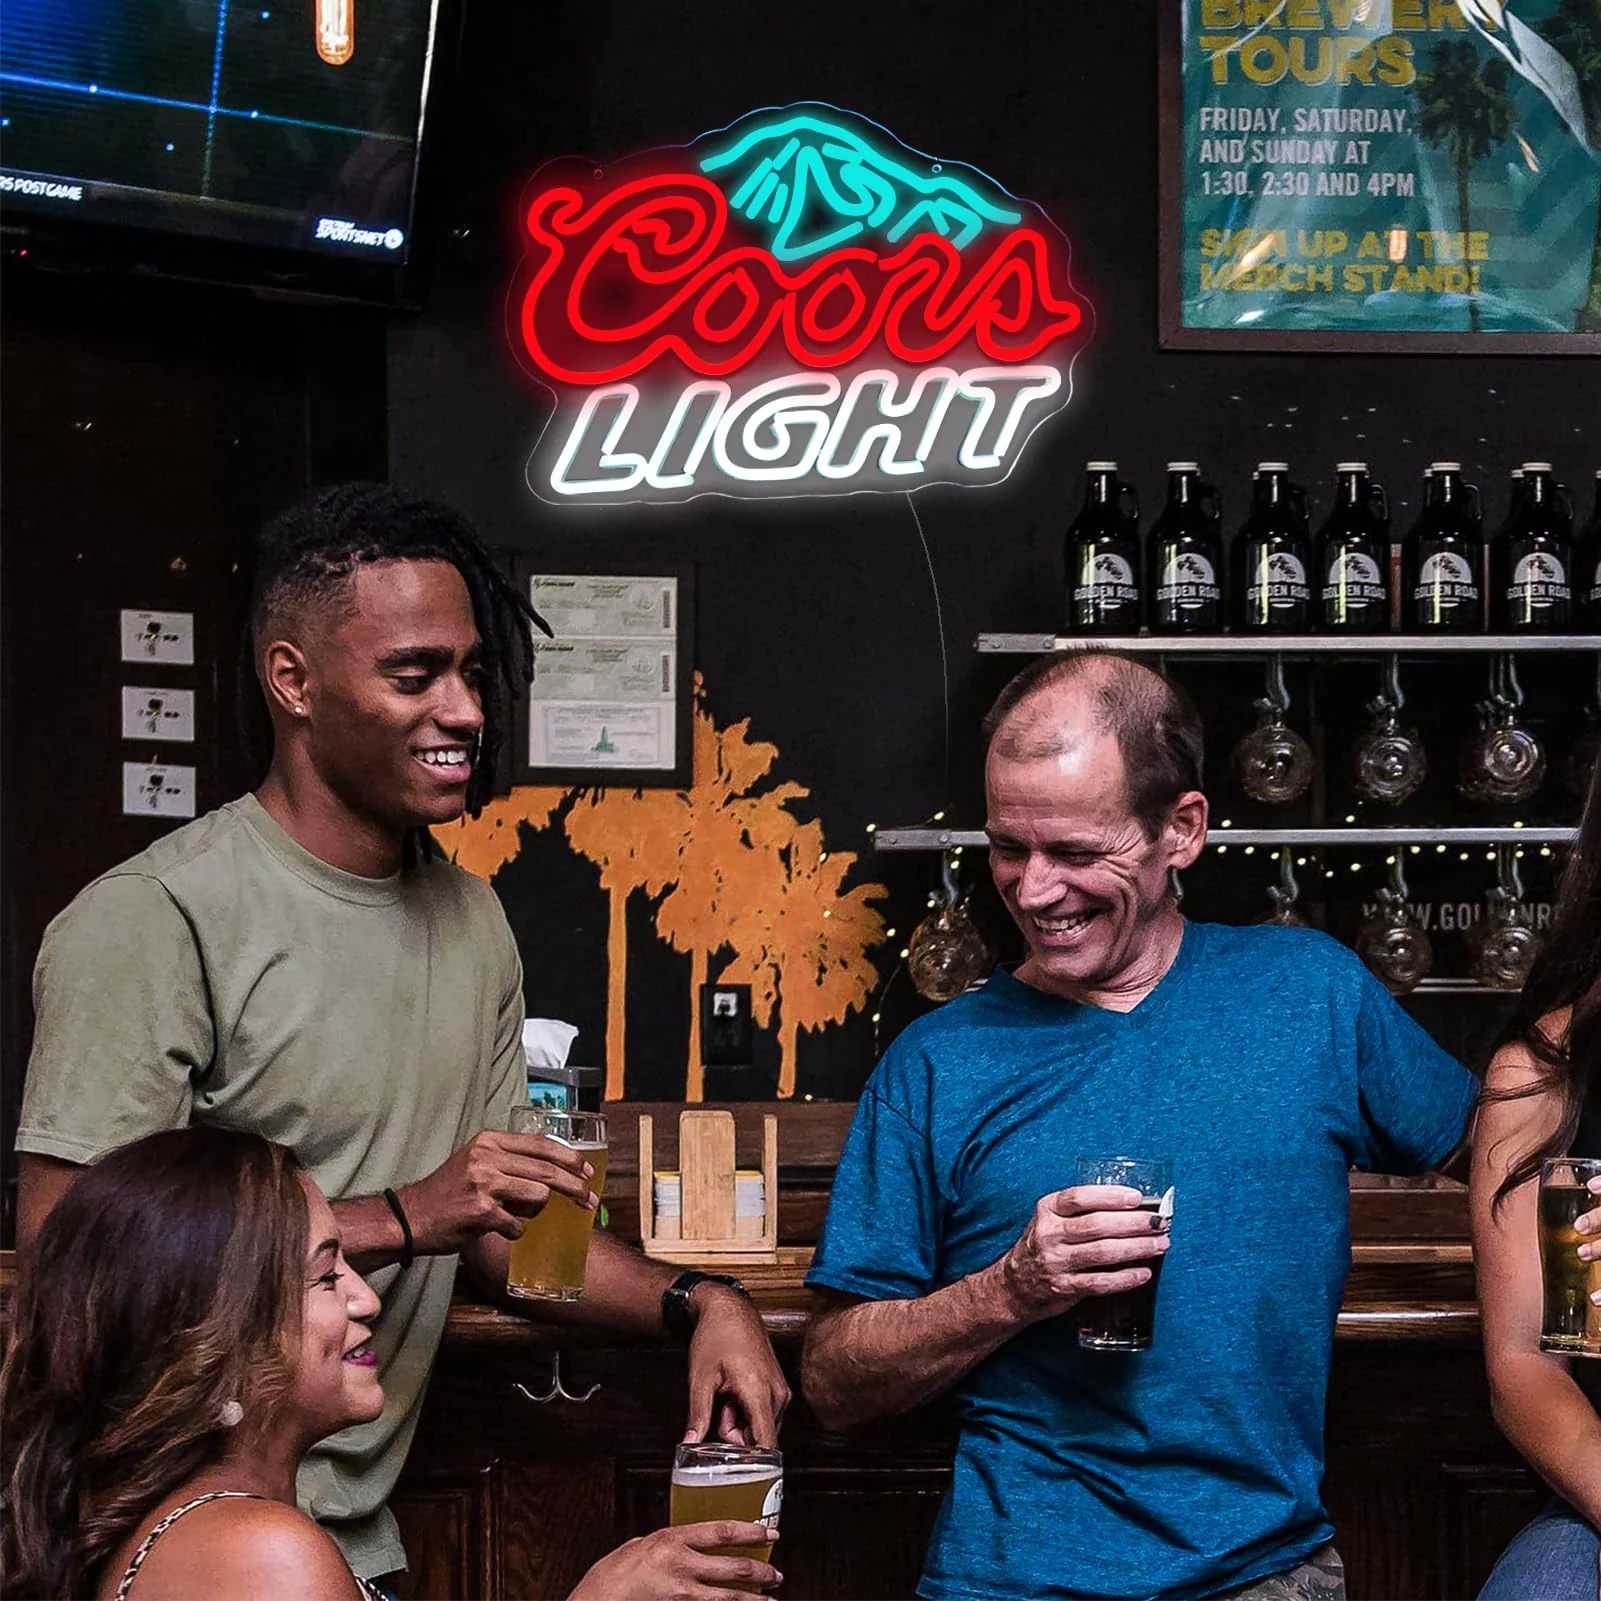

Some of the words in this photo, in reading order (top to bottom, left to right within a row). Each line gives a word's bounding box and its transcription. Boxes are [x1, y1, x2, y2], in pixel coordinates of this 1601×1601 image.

[1200, 35, 1416, 86] TOURS
[1294, 107, 1414, 135] SATURDAY,
[1200, 140, 1245, 164] AND
[1250, 140, 1338, 165] SUNDAY
[1344, 140, 1372, 164] AT
[1262, 172, 1309, 196] 2:30
[1316, 172, 1360, 196] AND
[1367, 172, 1415, 197] 4PM
[1298, 230, 1348, 257] UP
[1416, 231, 1490, 260] THE
[521, 172, 1081, 385] Coors
[1343, 263, 1481, 293] STAND!
[549, 365, 1061, 495] LIGHT
